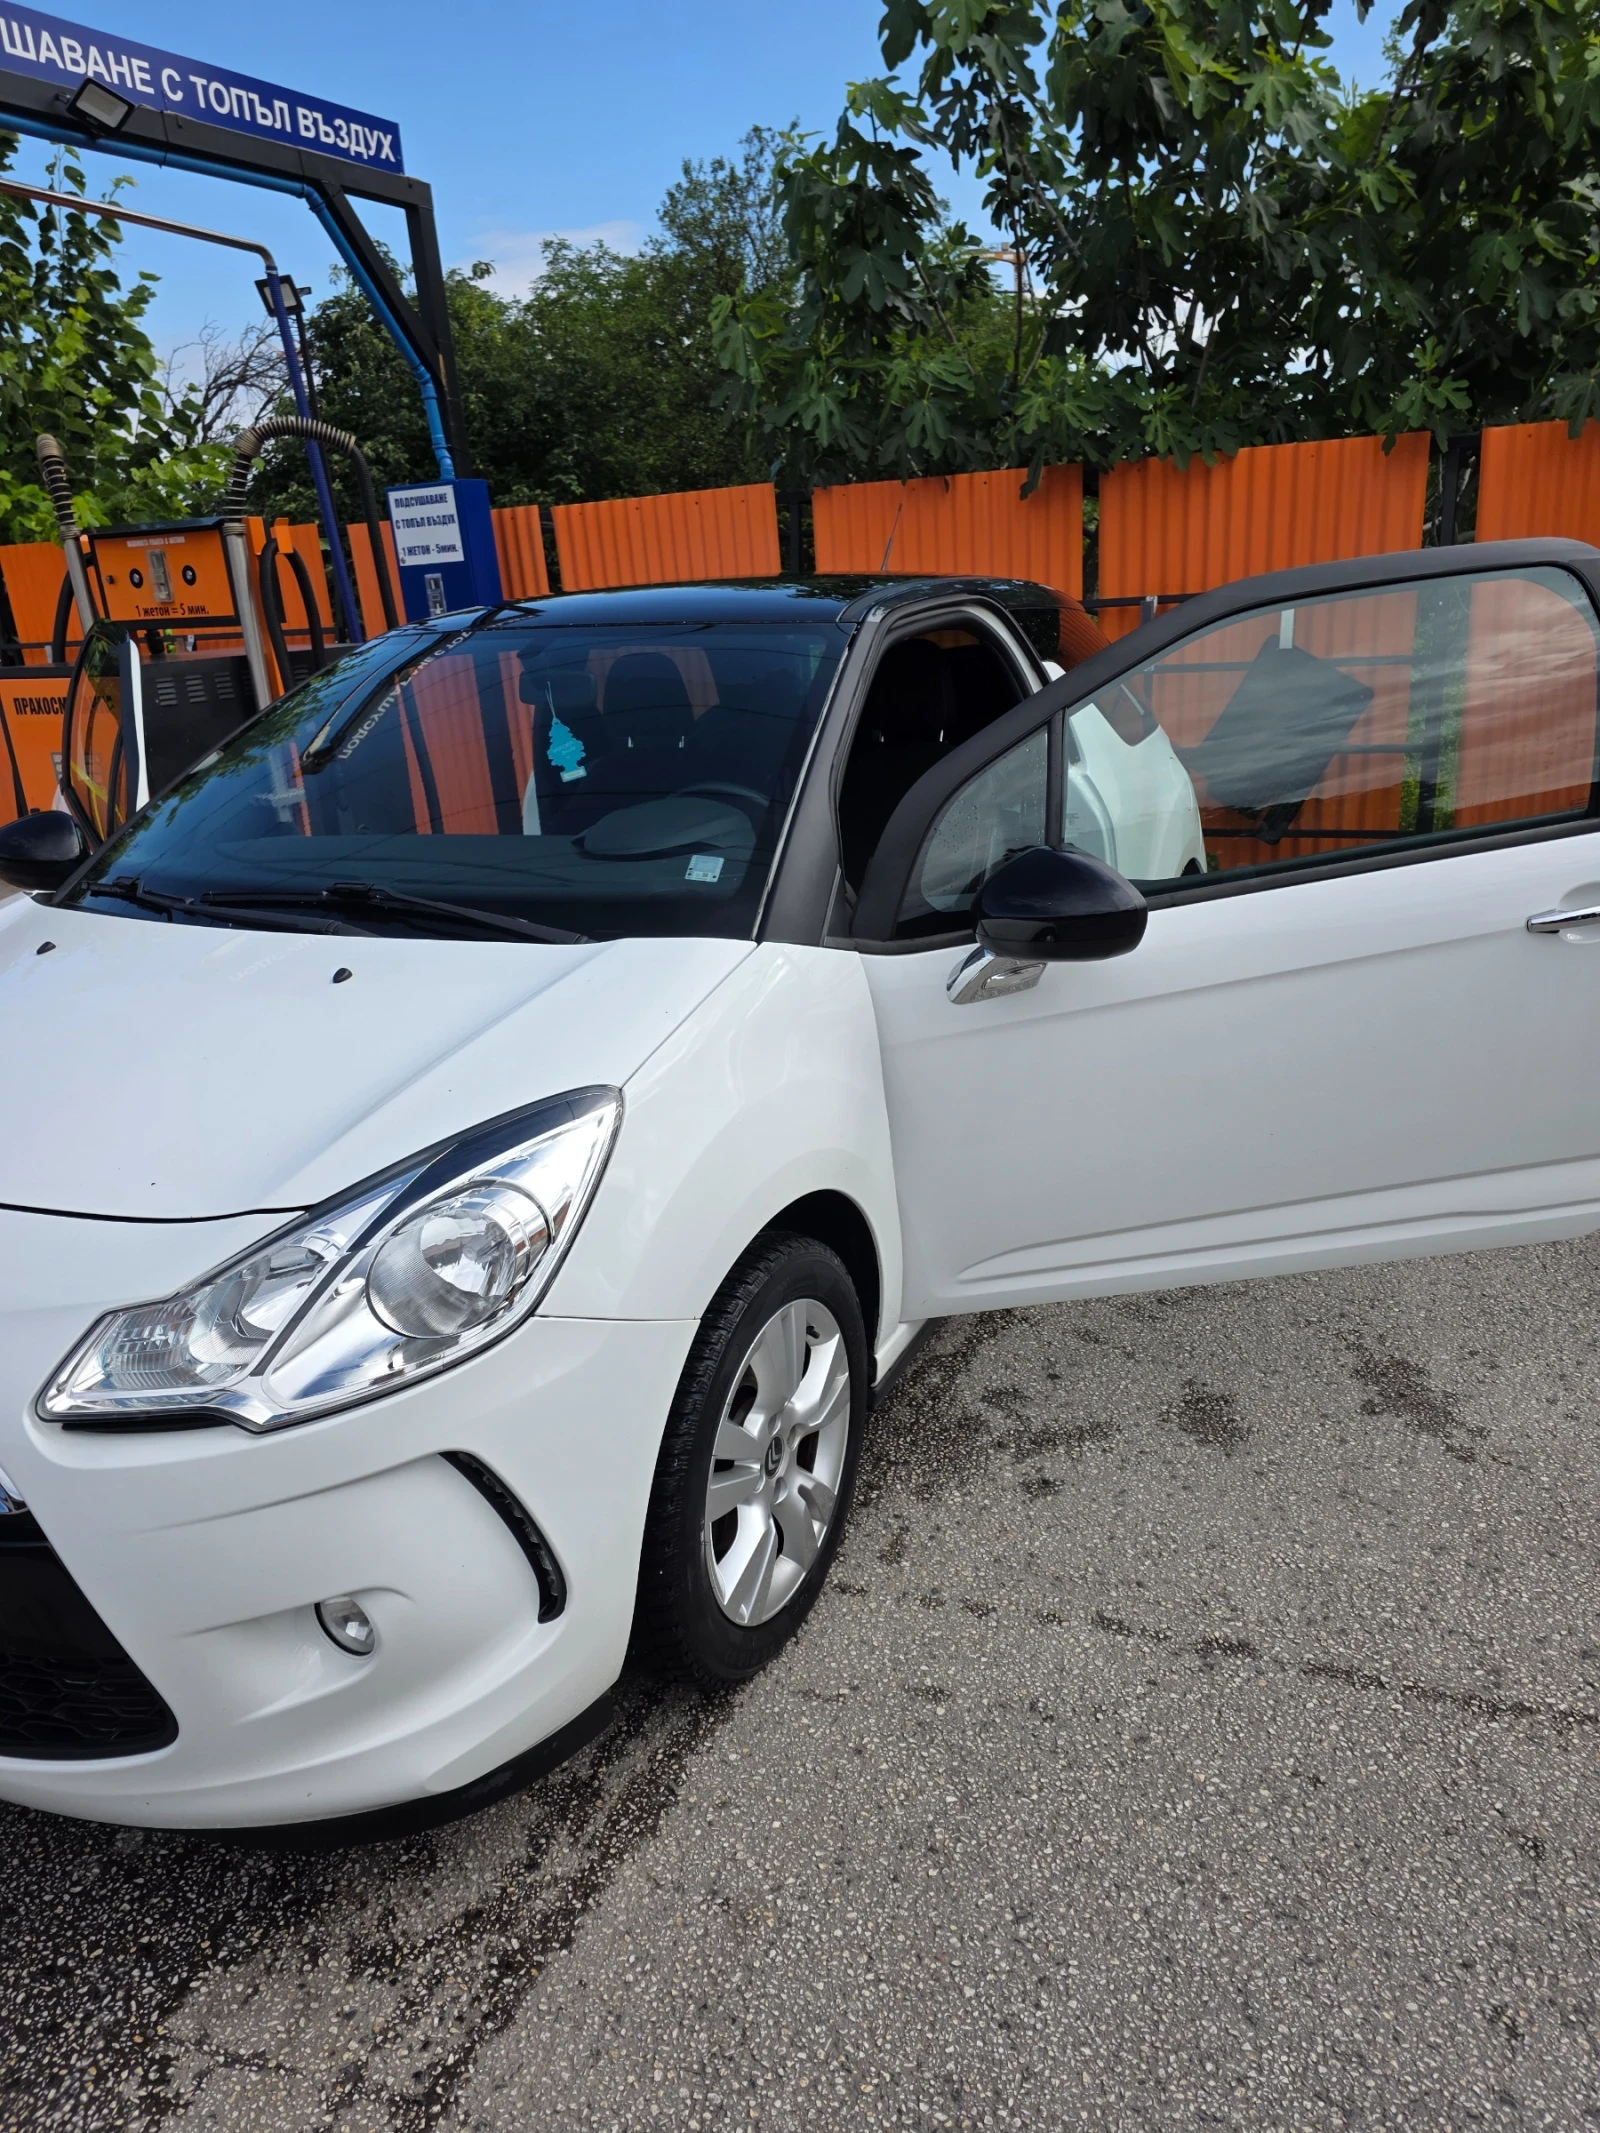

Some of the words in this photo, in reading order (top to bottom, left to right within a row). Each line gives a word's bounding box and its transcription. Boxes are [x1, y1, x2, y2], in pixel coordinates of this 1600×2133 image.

[0, 17, 155, 94] ШАВАНЕ
[161, 68, 183, 101] С
[189, 75, 292, 133] ТОПЪЛ
[297, 107, 396, 162] ВЪЗДУХ
[394, 493, 448, 508] ПОДСУШАВАНЕ
[395, 519, 401, 530] С
[401, 517, 426, 529] ТОПЪЛ
[427, 514, 456, 527] ВЪЗДУХ
[402, 547, 406, 556] 1
[407, 545, 431, 556] ЖЕТОН
[135, 605, 141, 617] 1
[142, 606, 170, 617] жетон
[180, 603, 186, 616] 5
[187, 605, 210, 615] мин.
[13, 697, 66, 715] ПРАХОСМ
